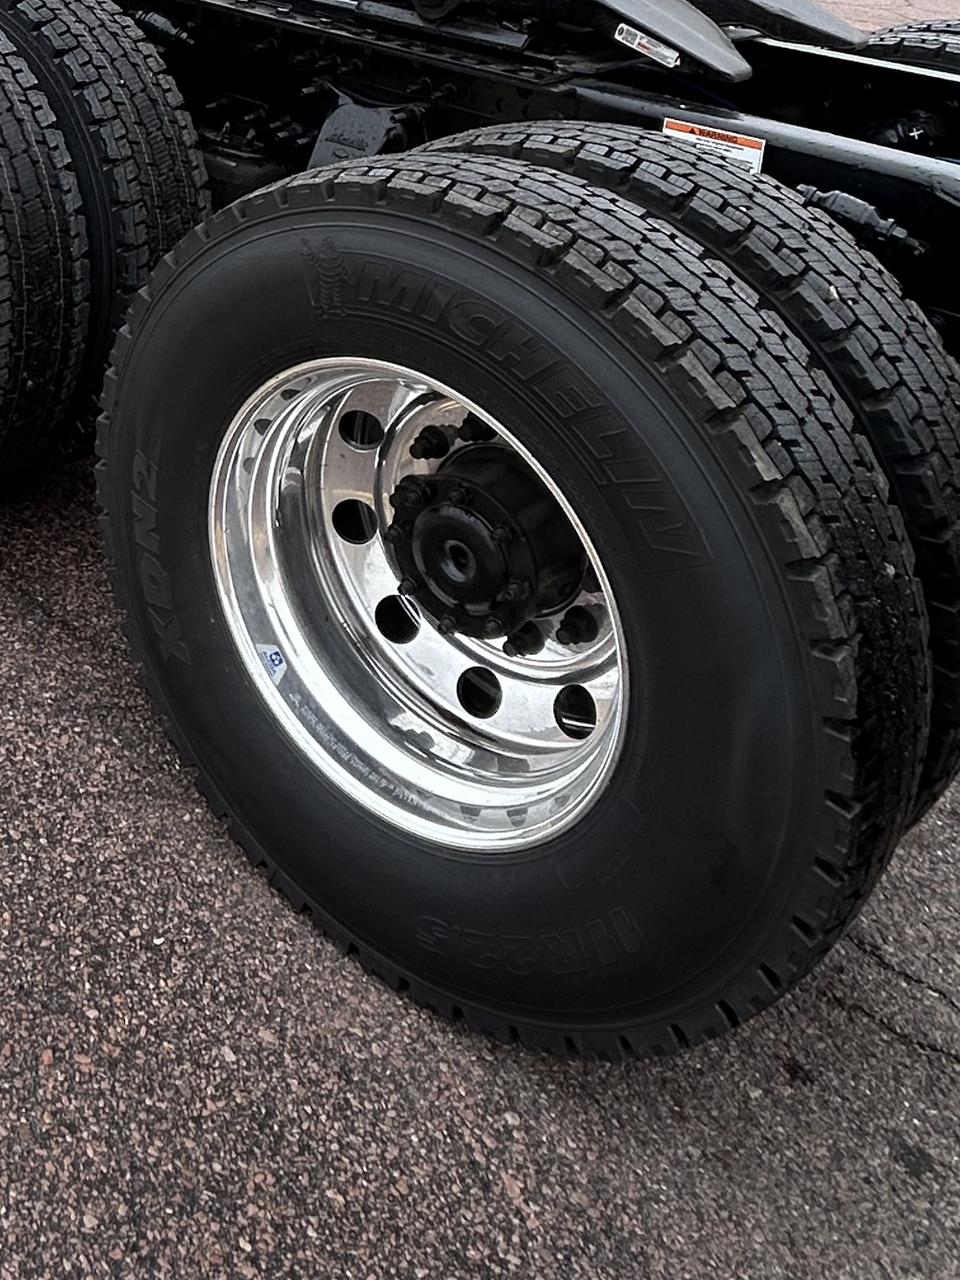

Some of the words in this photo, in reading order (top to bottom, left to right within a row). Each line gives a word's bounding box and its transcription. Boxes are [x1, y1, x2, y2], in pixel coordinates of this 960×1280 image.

[698, 128, 738, 144] WARNING
[357, 261, 709, 559] MICHELIN
[130, 447, 193, 666] XDN2
